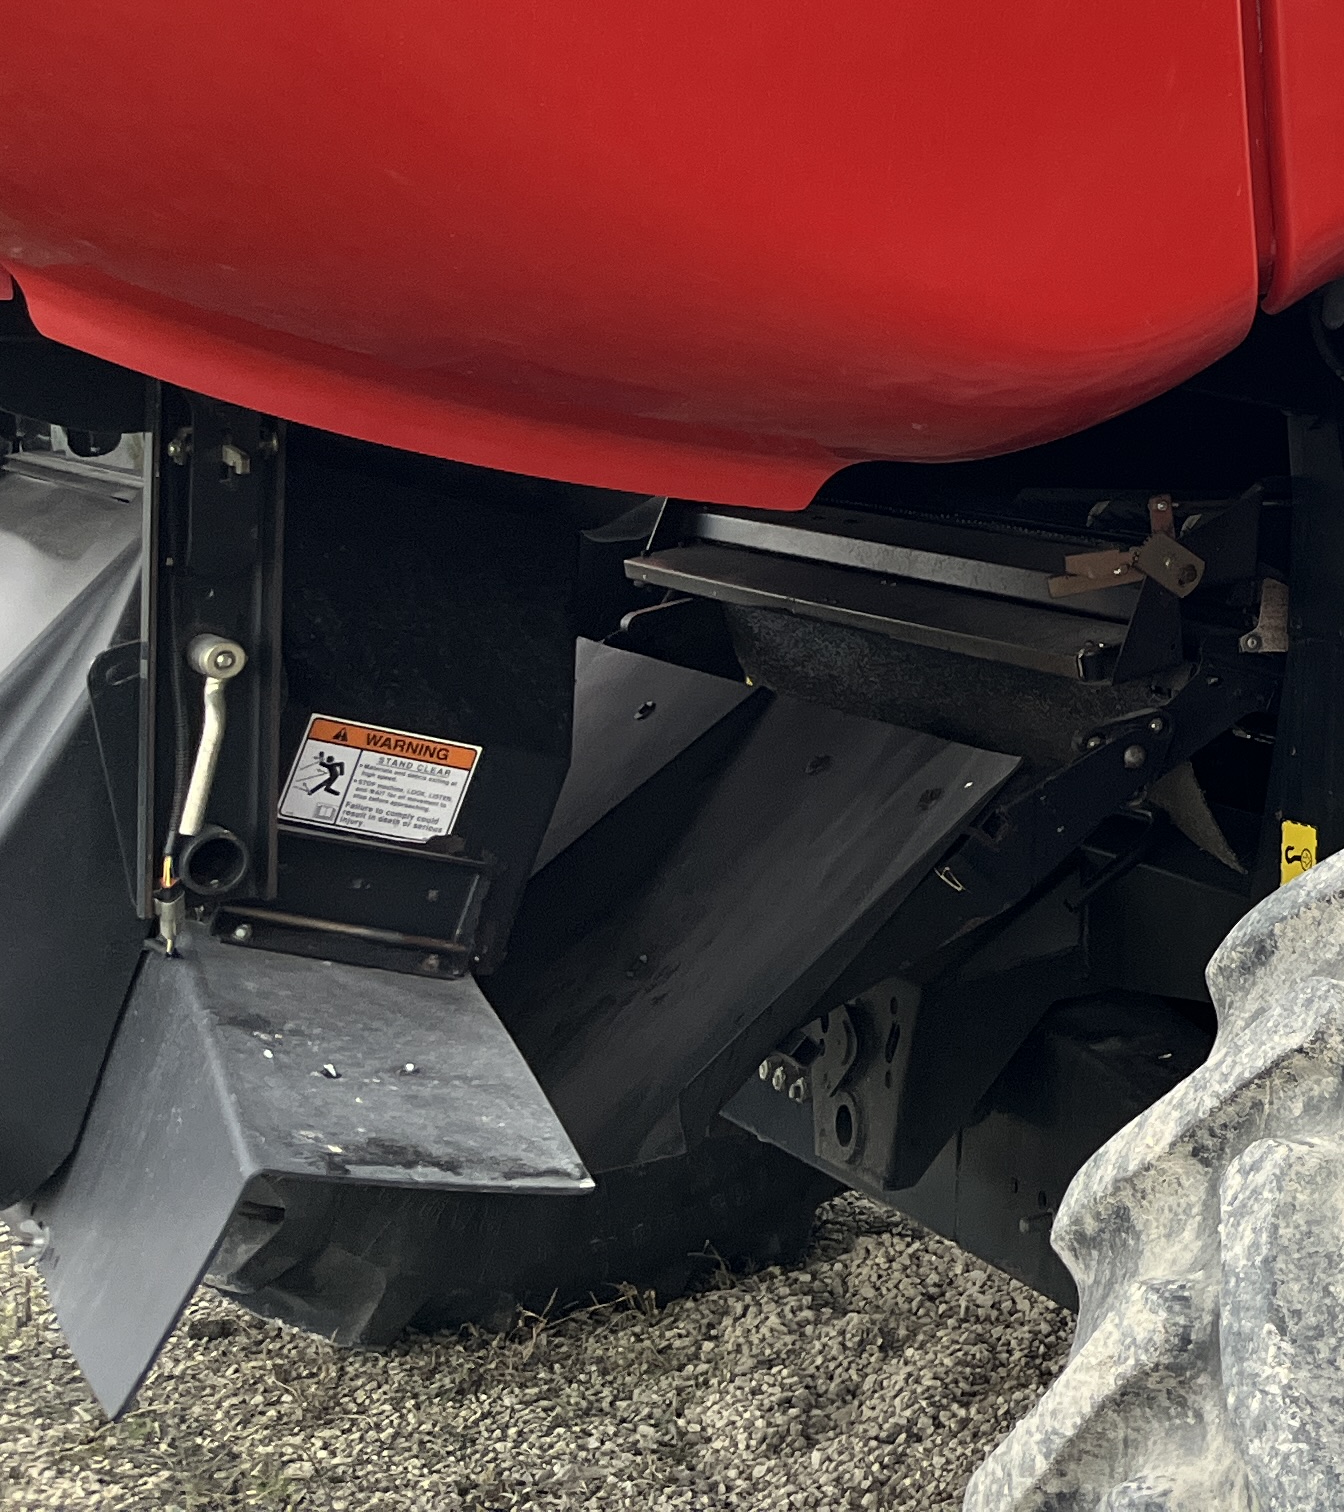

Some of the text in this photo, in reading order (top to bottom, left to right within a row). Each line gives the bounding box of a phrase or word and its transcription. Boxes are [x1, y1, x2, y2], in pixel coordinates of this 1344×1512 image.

[365, 732, 450, 762] WARNING
[378, 757, 451, 776] STAND CLEAR
[342, 809, 367, 819] result
[368, 813, 376, 821] in
[378, 816, 401, 826] death
[413, 823, 443, 833] serious
[345, 801, 440, 825] Failure to comply could
